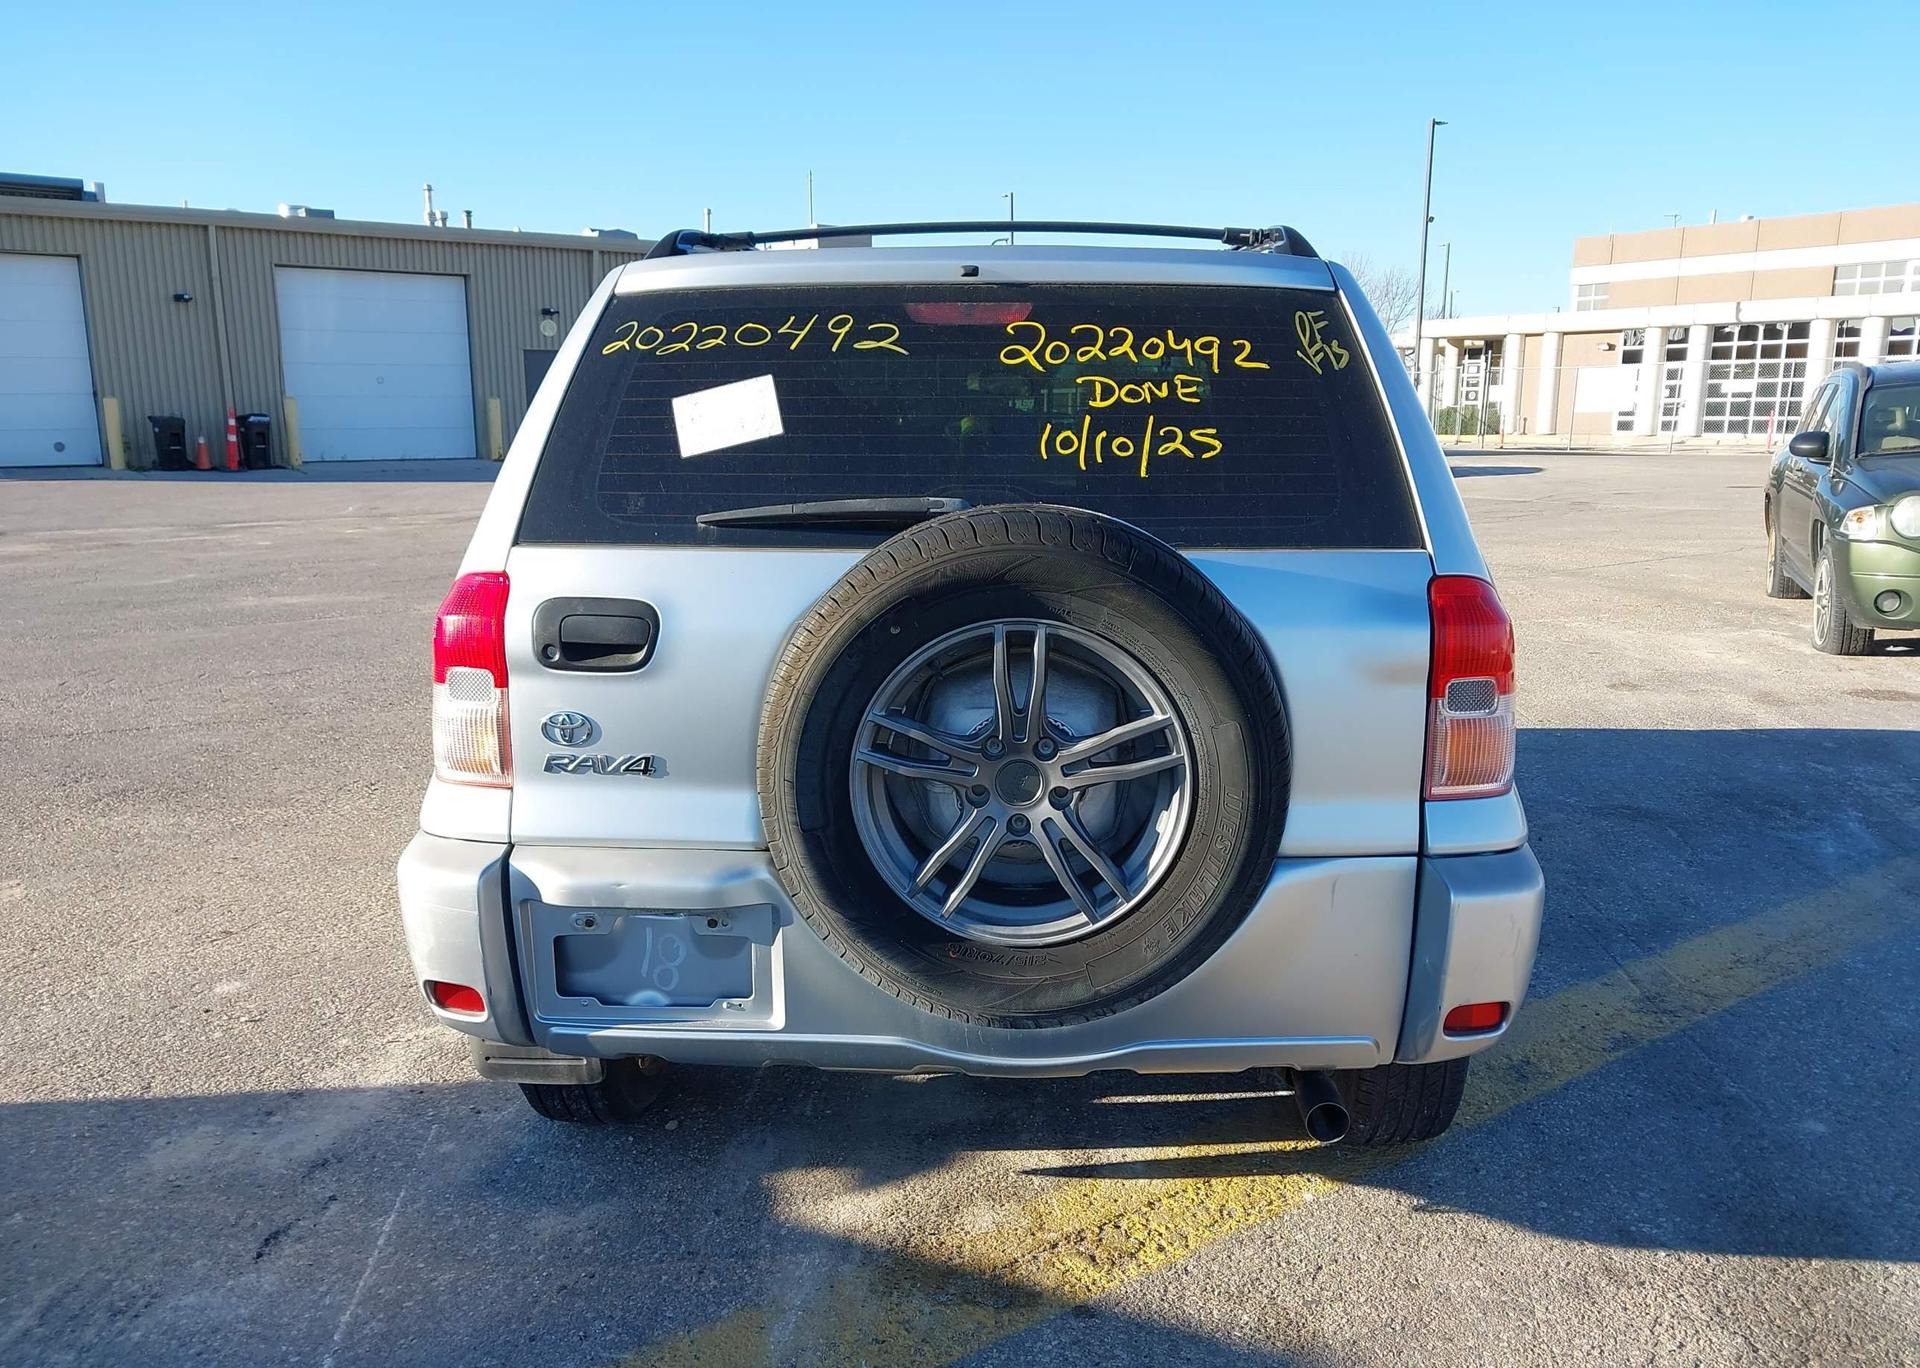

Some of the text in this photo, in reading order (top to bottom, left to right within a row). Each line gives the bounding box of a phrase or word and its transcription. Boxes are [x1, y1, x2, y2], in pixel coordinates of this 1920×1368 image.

[602, 314, 909, 356] 20220492
[1000, 321, 1270, 374] 20220492
[1076, 375, 1204, 408] DONE
[1040, 414, 1224, 478] 10/10/25
[543, 753, 657, 778] RAV4
[1162, 786, 1246, 943] WESTLAKE
